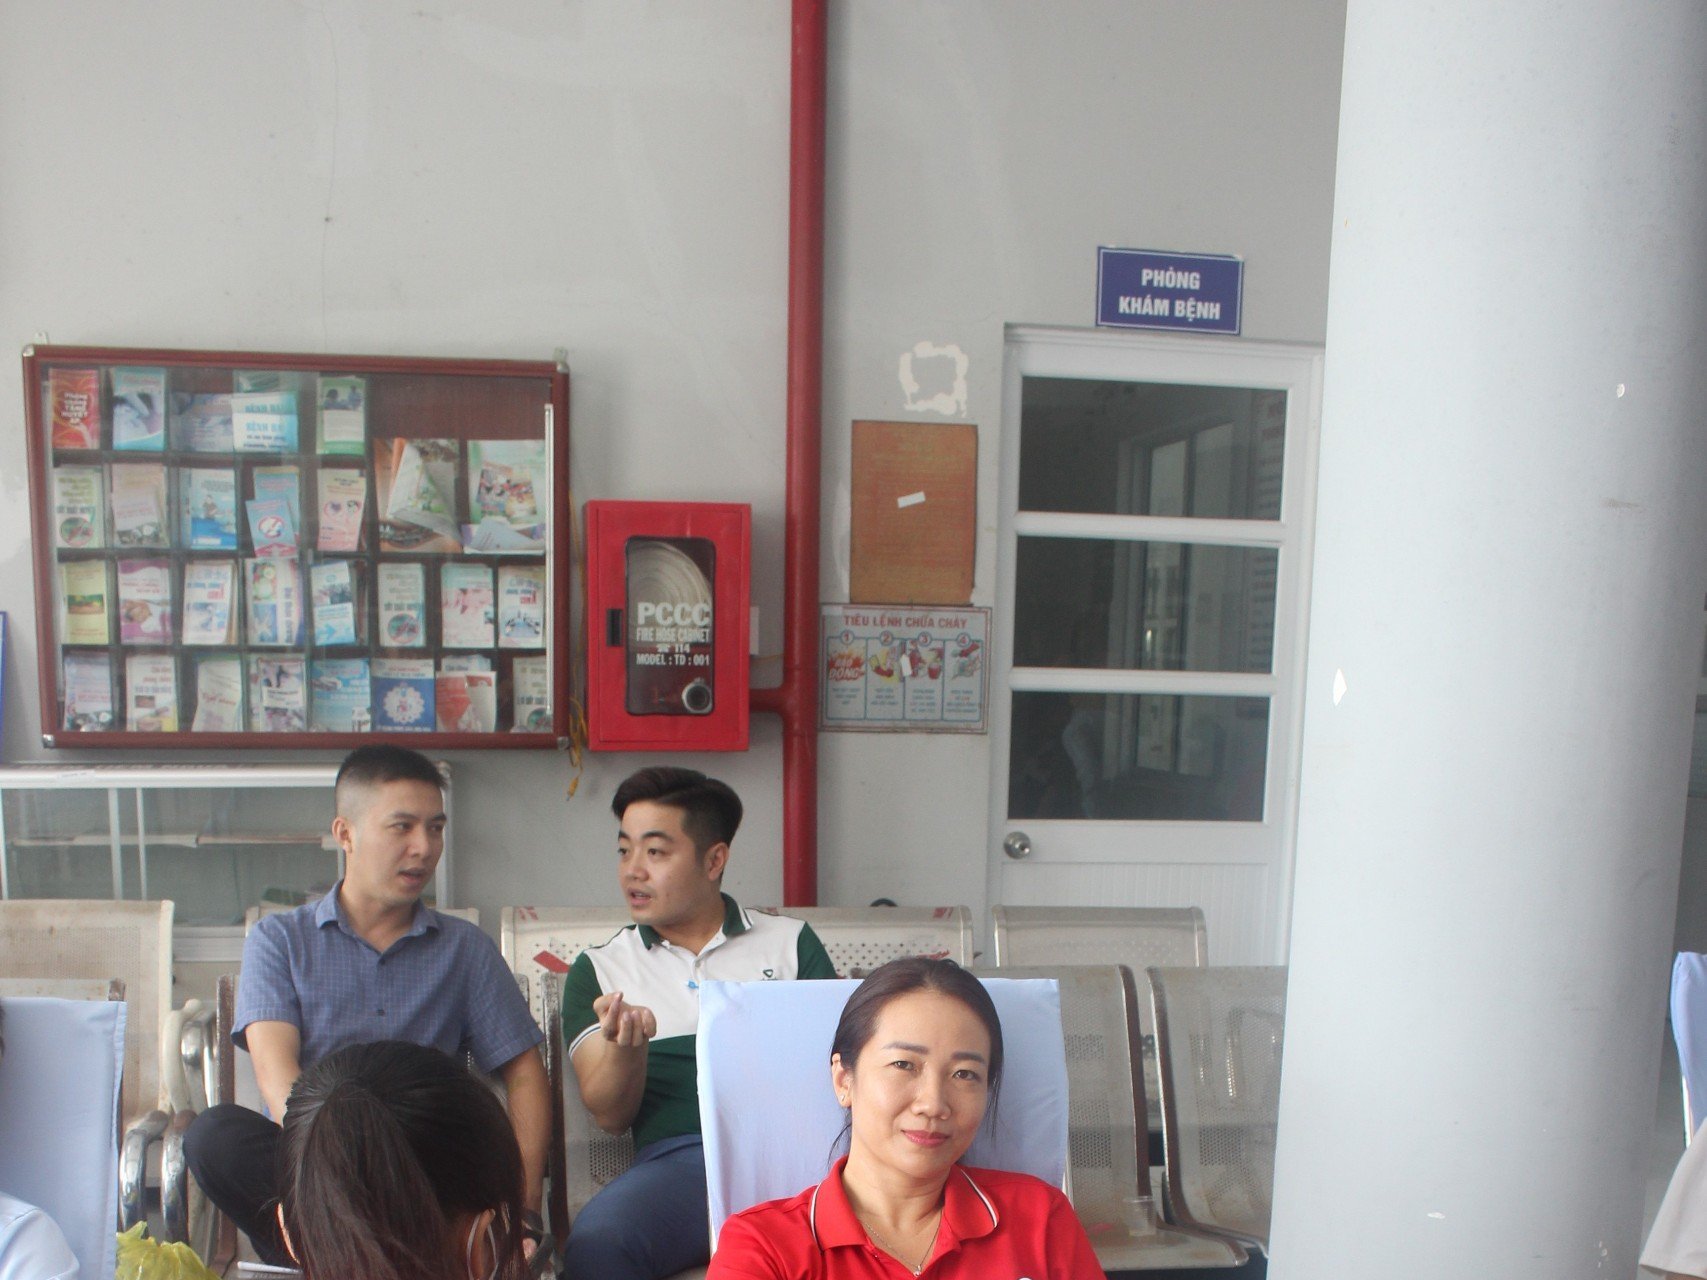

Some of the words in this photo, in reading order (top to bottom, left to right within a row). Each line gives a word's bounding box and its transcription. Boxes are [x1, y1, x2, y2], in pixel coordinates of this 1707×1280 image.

[1119, 294, 1170, 316] KHÁM
[1174, 297, 1221, 322] BỆNH
[637, 601, 710, 626] PCCC
[844, 613, 869, 626] TIÊU
[873, 613, 902, 628] LỆNH
[905, 613, 935, 628] CHỮA
[636, 627, 654, 642] FIRE
[844, 633, 850, 641] 1
[883, 633, 890, 643] 2
[921, 634, 928, 644] 3
[675, 643, 691, 653] 114
[636, 653, 666, 666] MODEL
[673, 653, 687, 666] TD
[693, 654, 710, 666] 001
